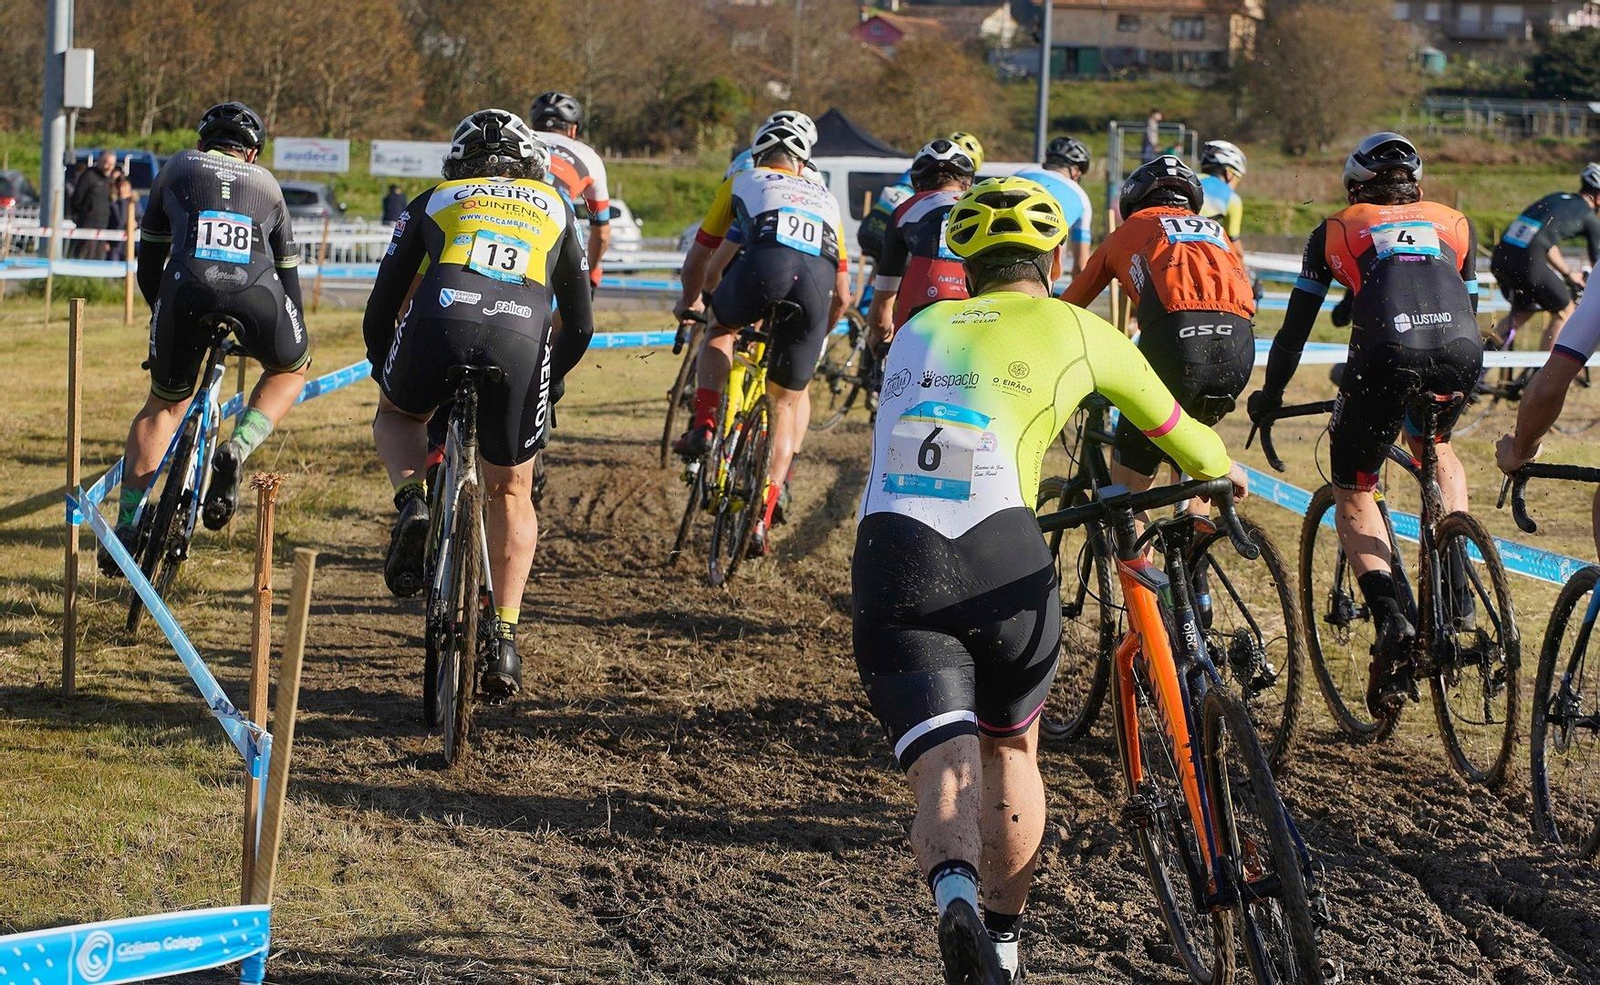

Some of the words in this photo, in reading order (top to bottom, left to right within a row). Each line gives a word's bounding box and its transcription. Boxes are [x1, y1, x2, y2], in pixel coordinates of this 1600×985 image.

[453, 187, 548, 211] CAEIRO
[461, 200, 542, 222] QUINTENA
[203, 222, 249, 250] 138
[788, 215, 815, 242] 90
[1165, 218, 1221, 238] 199
[1397, 230, 1415, 245] 4
[487, 243, 518, 271] 13
[486, 301, 532, 318] galicia
[1411, 312, 1452, 325] LUSTAND
[1179, 324, 1233, 339] GSG
[934, 371, 980, 390] espacio
[917, 427, 944, 472] 6
